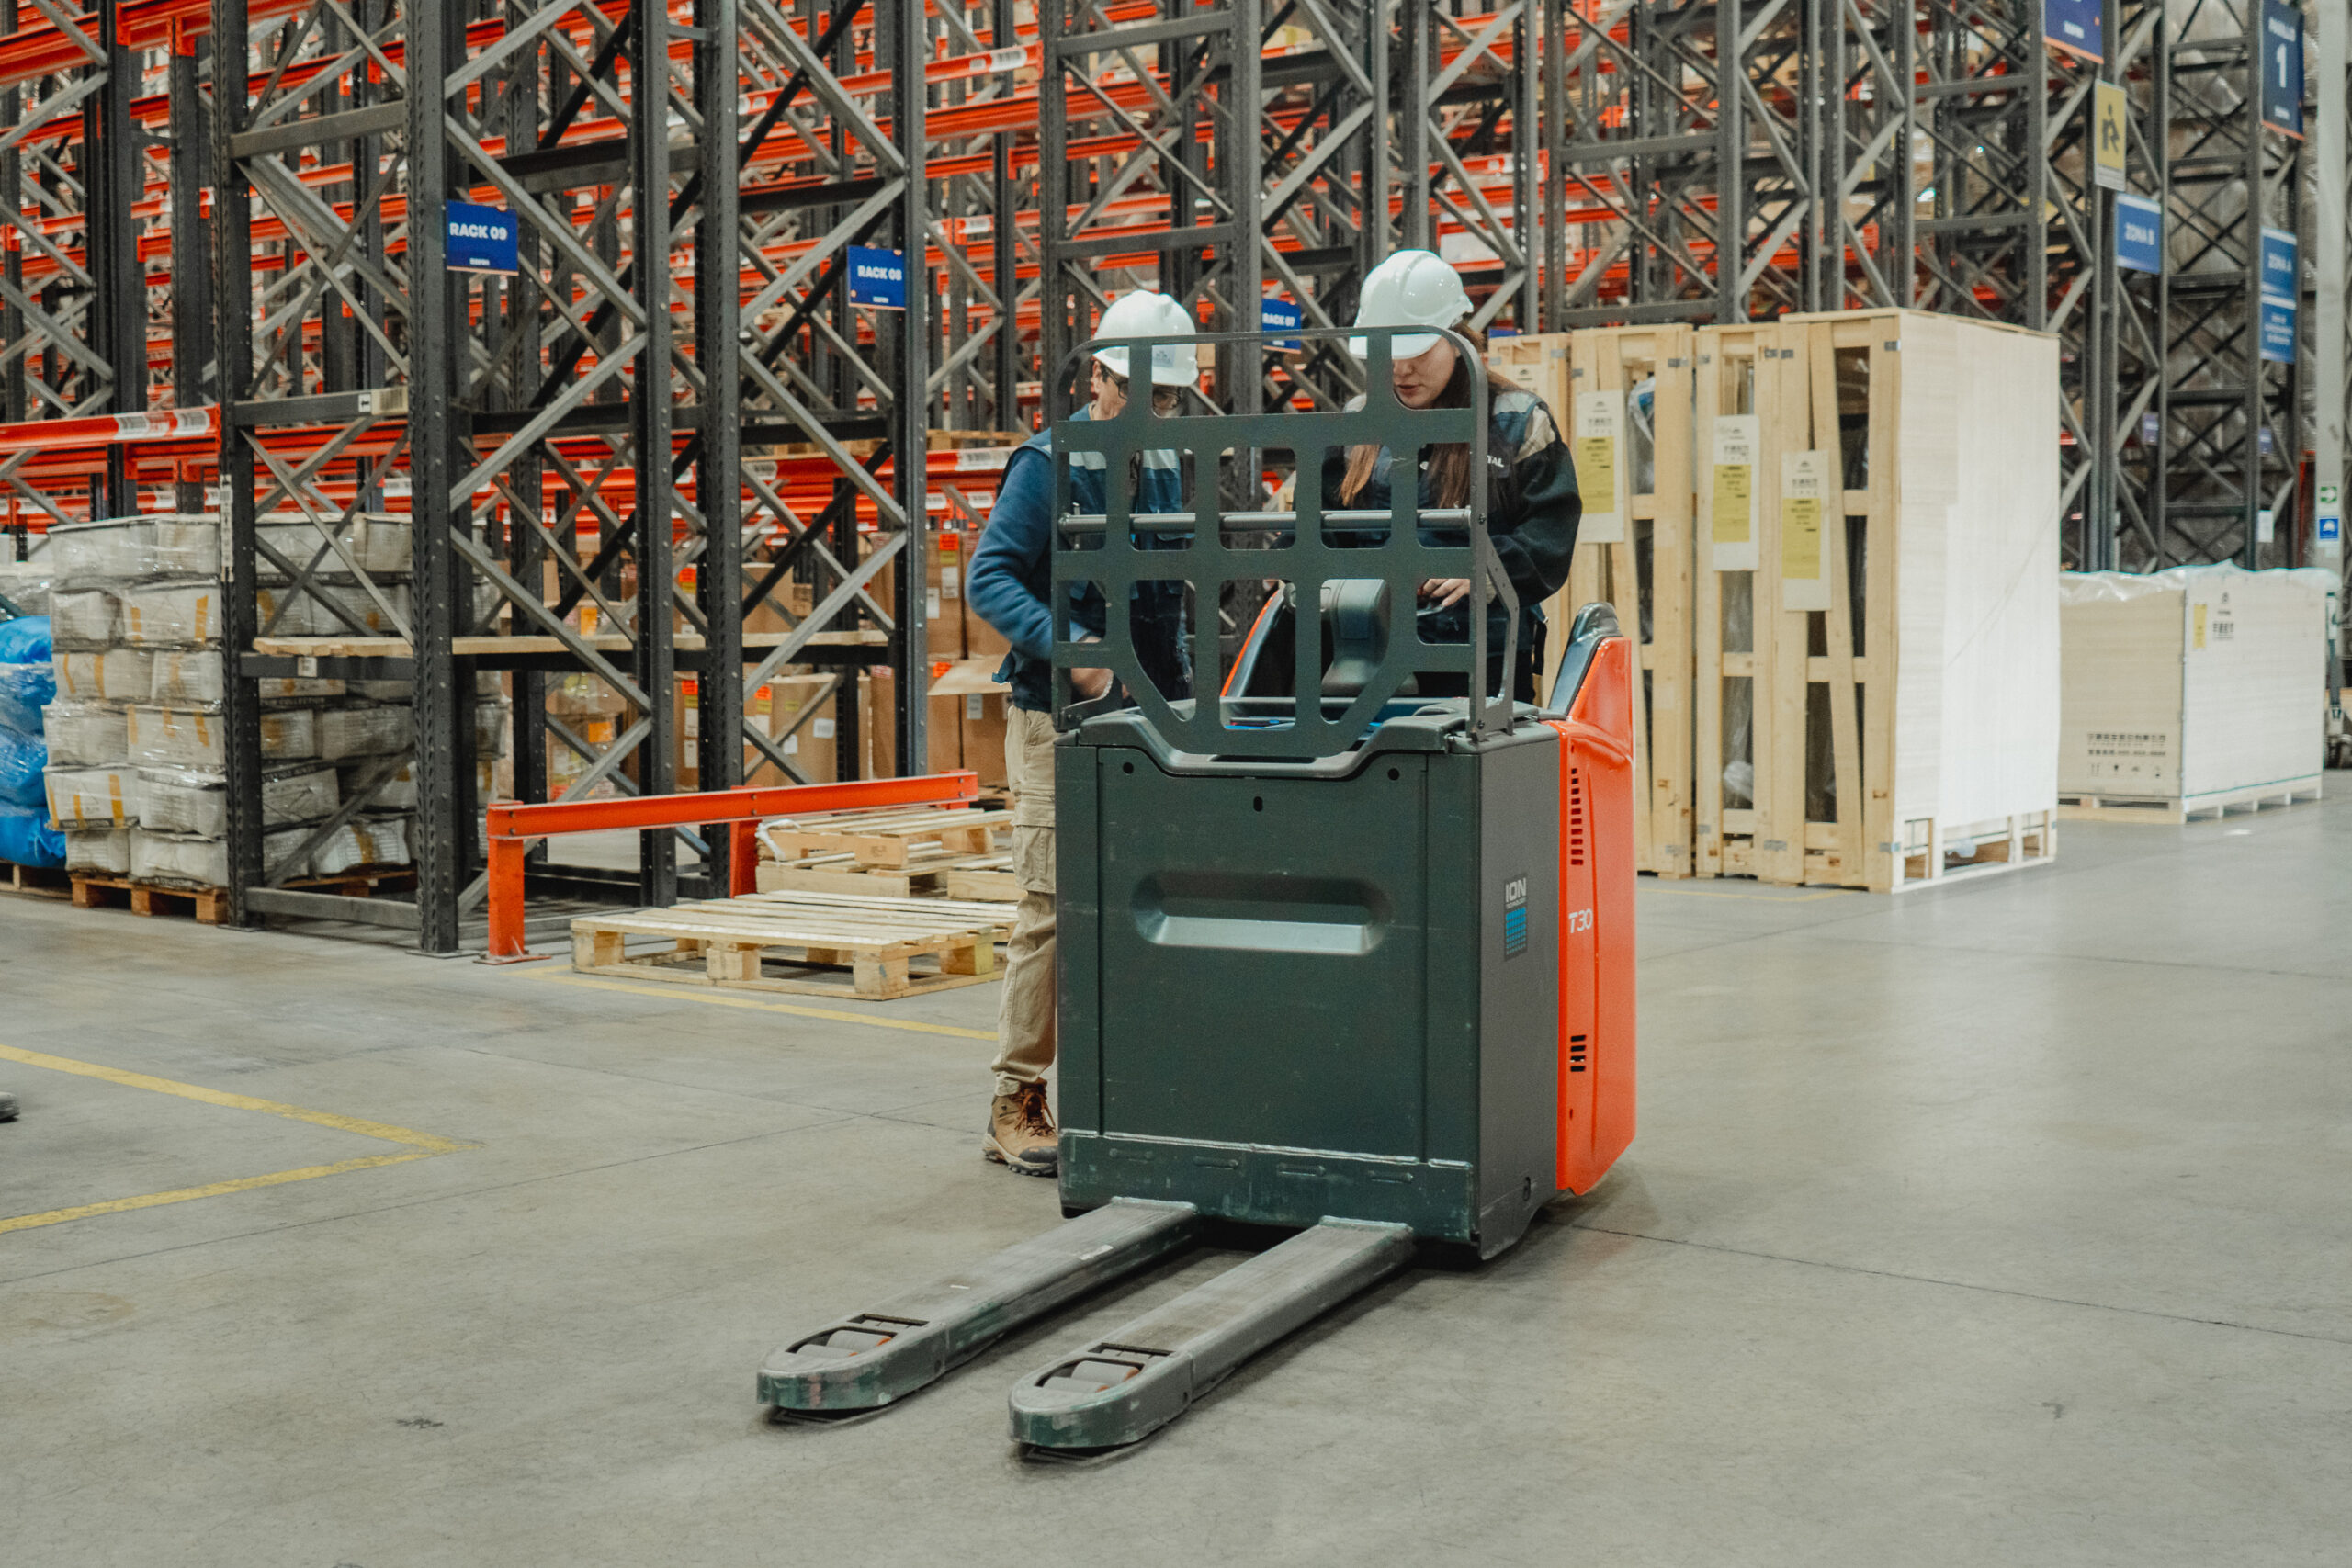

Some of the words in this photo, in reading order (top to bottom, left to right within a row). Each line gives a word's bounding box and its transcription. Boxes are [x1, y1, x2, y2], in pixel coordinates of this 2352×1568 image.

[2276, 42, 2287, 88] 1
[449, 222, 489, 239] RACK
[490, 226, 508, 241] 09
[857, 265, 888, 280] RACK
[1262, 312, 1284, 326] RACK
[1505, 877, 1527, 903] ION
[1568, 908, 1593, 934] T30
